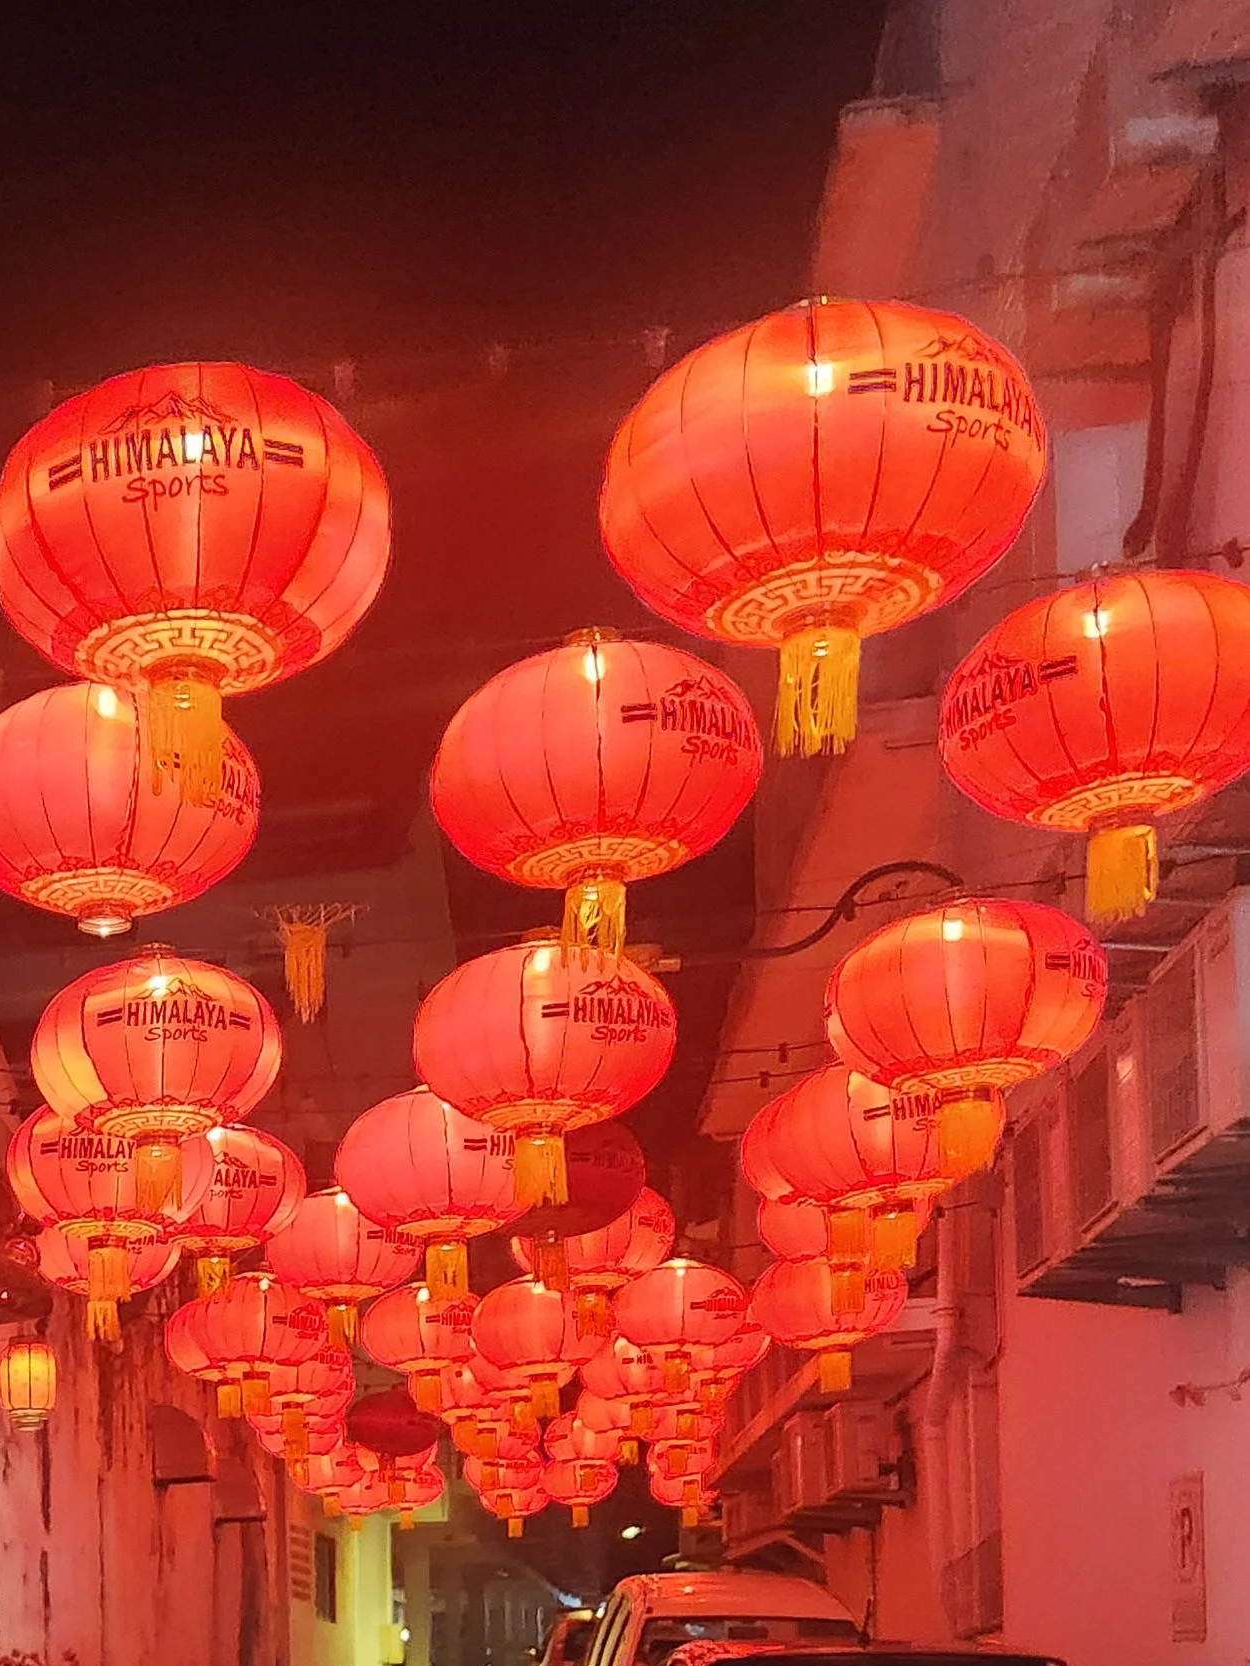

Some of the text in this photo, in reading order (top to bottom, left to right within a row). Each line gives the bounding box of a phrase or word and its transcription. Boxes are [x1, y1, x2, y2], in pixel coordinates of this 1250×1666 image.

[903, 361, 1033, 437] HIMALAYA
[89, 426, 261, 483] HIMALAYA
[126, 999, 228, 1031] HIMALAYA
[573, 996, 661, 1029] HIMALAYA
[60, 1137, 136, 1160] HIMALAY
